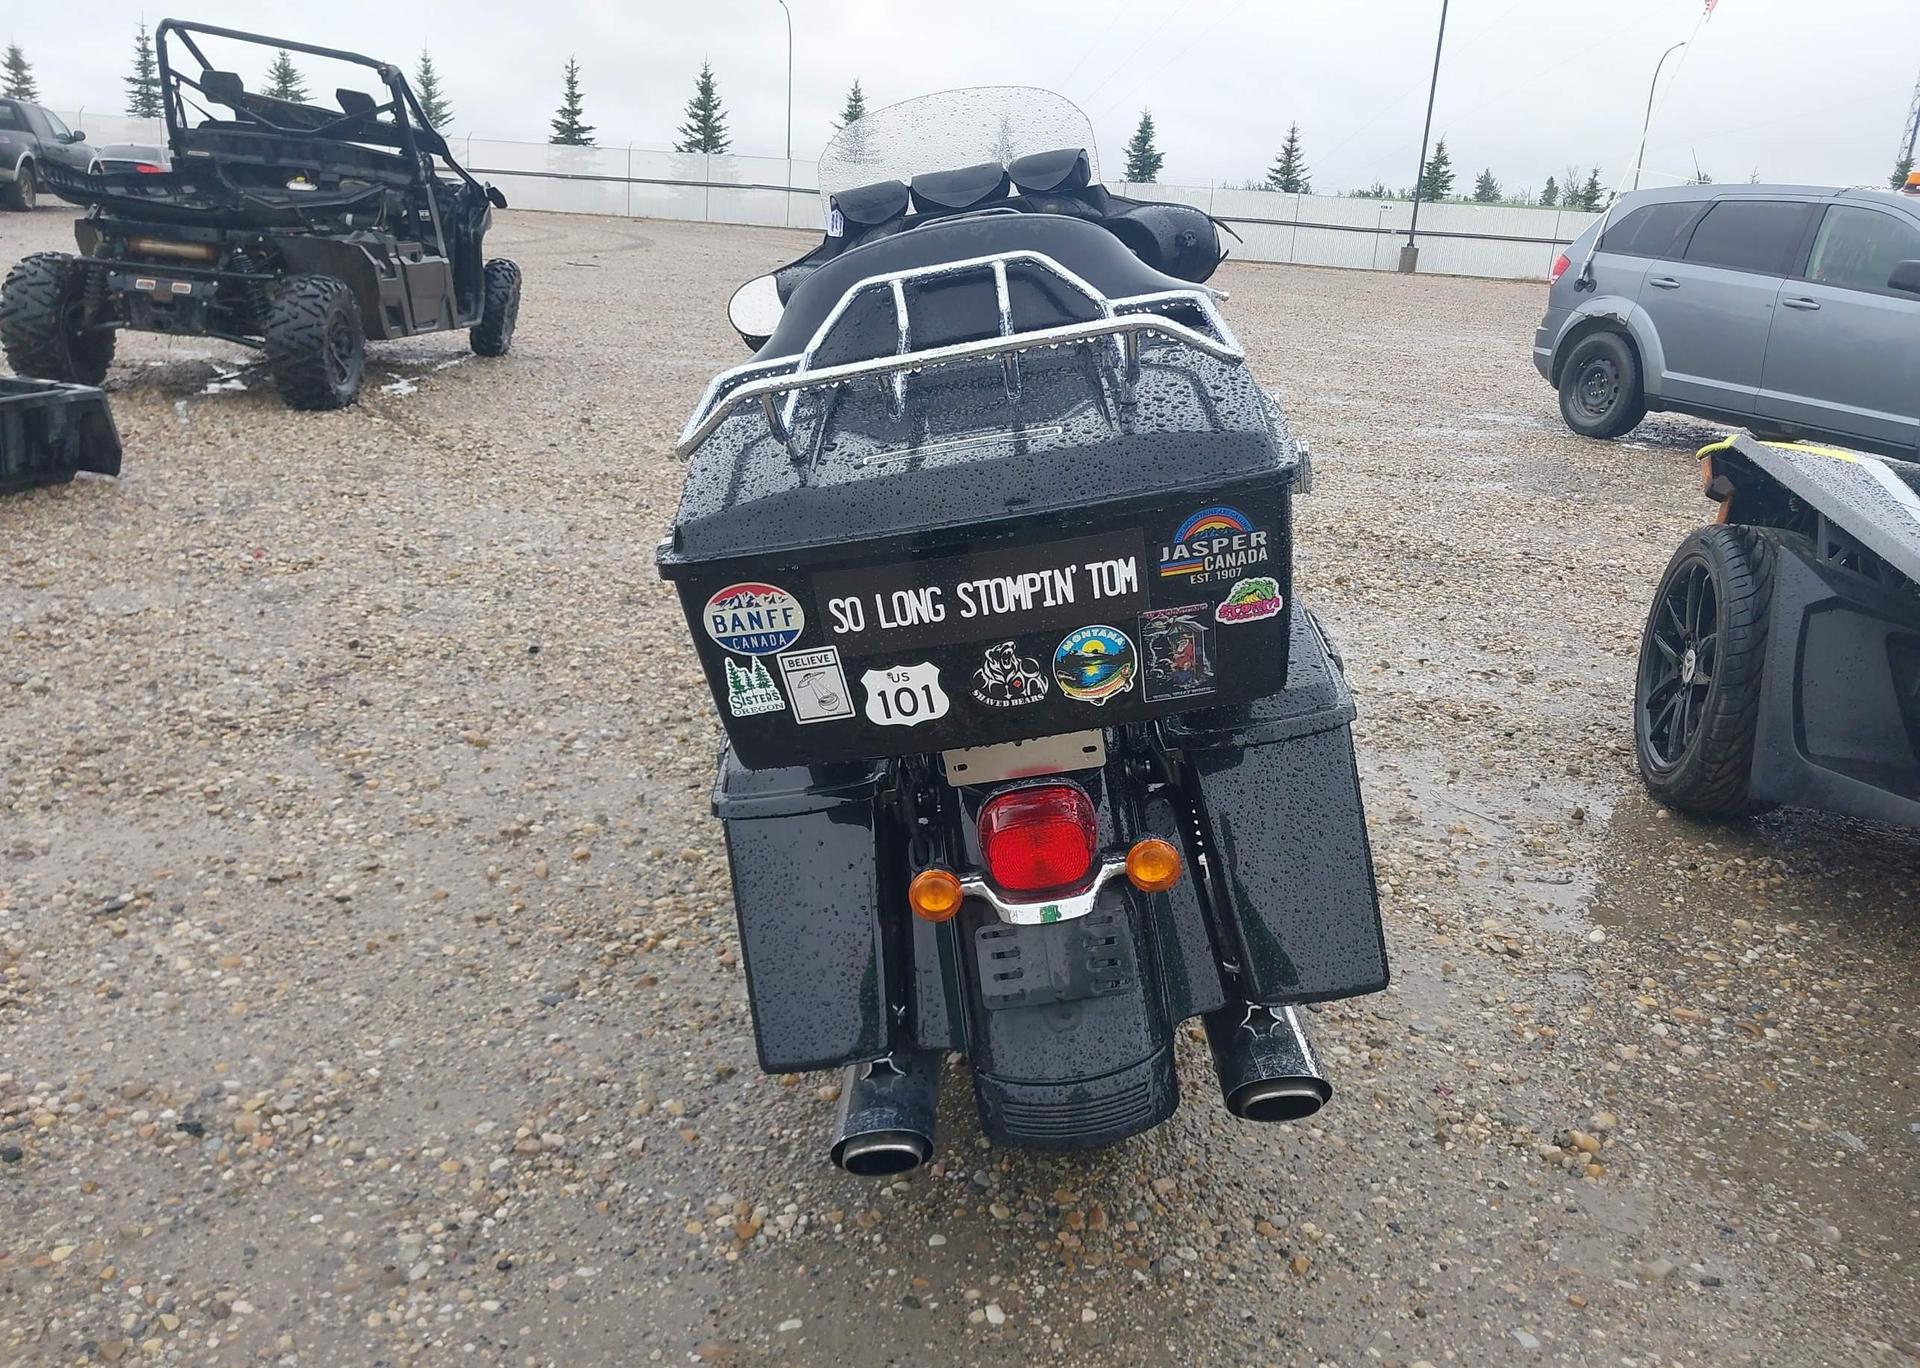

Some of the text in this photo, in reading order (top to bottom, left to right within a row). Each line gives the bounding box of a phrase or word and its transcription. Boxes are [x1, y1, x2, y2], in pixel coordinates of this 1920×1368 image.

[1160, 531, 1267, 562] JASPER
[1204, 547, 1268, 572] CANADA
[1190, 568, 1242, 585] EST. 1907
[828, 556, 1138, 634] SO LONG STOMPIN' TOM
[712, 607, 794, 634] BANFF
[732, 633, 787, 650] CANADA
[1062, 628, 1126, 652] MONTANA
[788, 654, 831, 668] BELIEVE
[891, 671, 911, 683] US
[730, 692, 781, 710] SISTERS
[877, 684, 936, 719] 101
[971, 689, 1045, 708] SHAVED BEARS
[733, 702, 785, 716] OREGON
